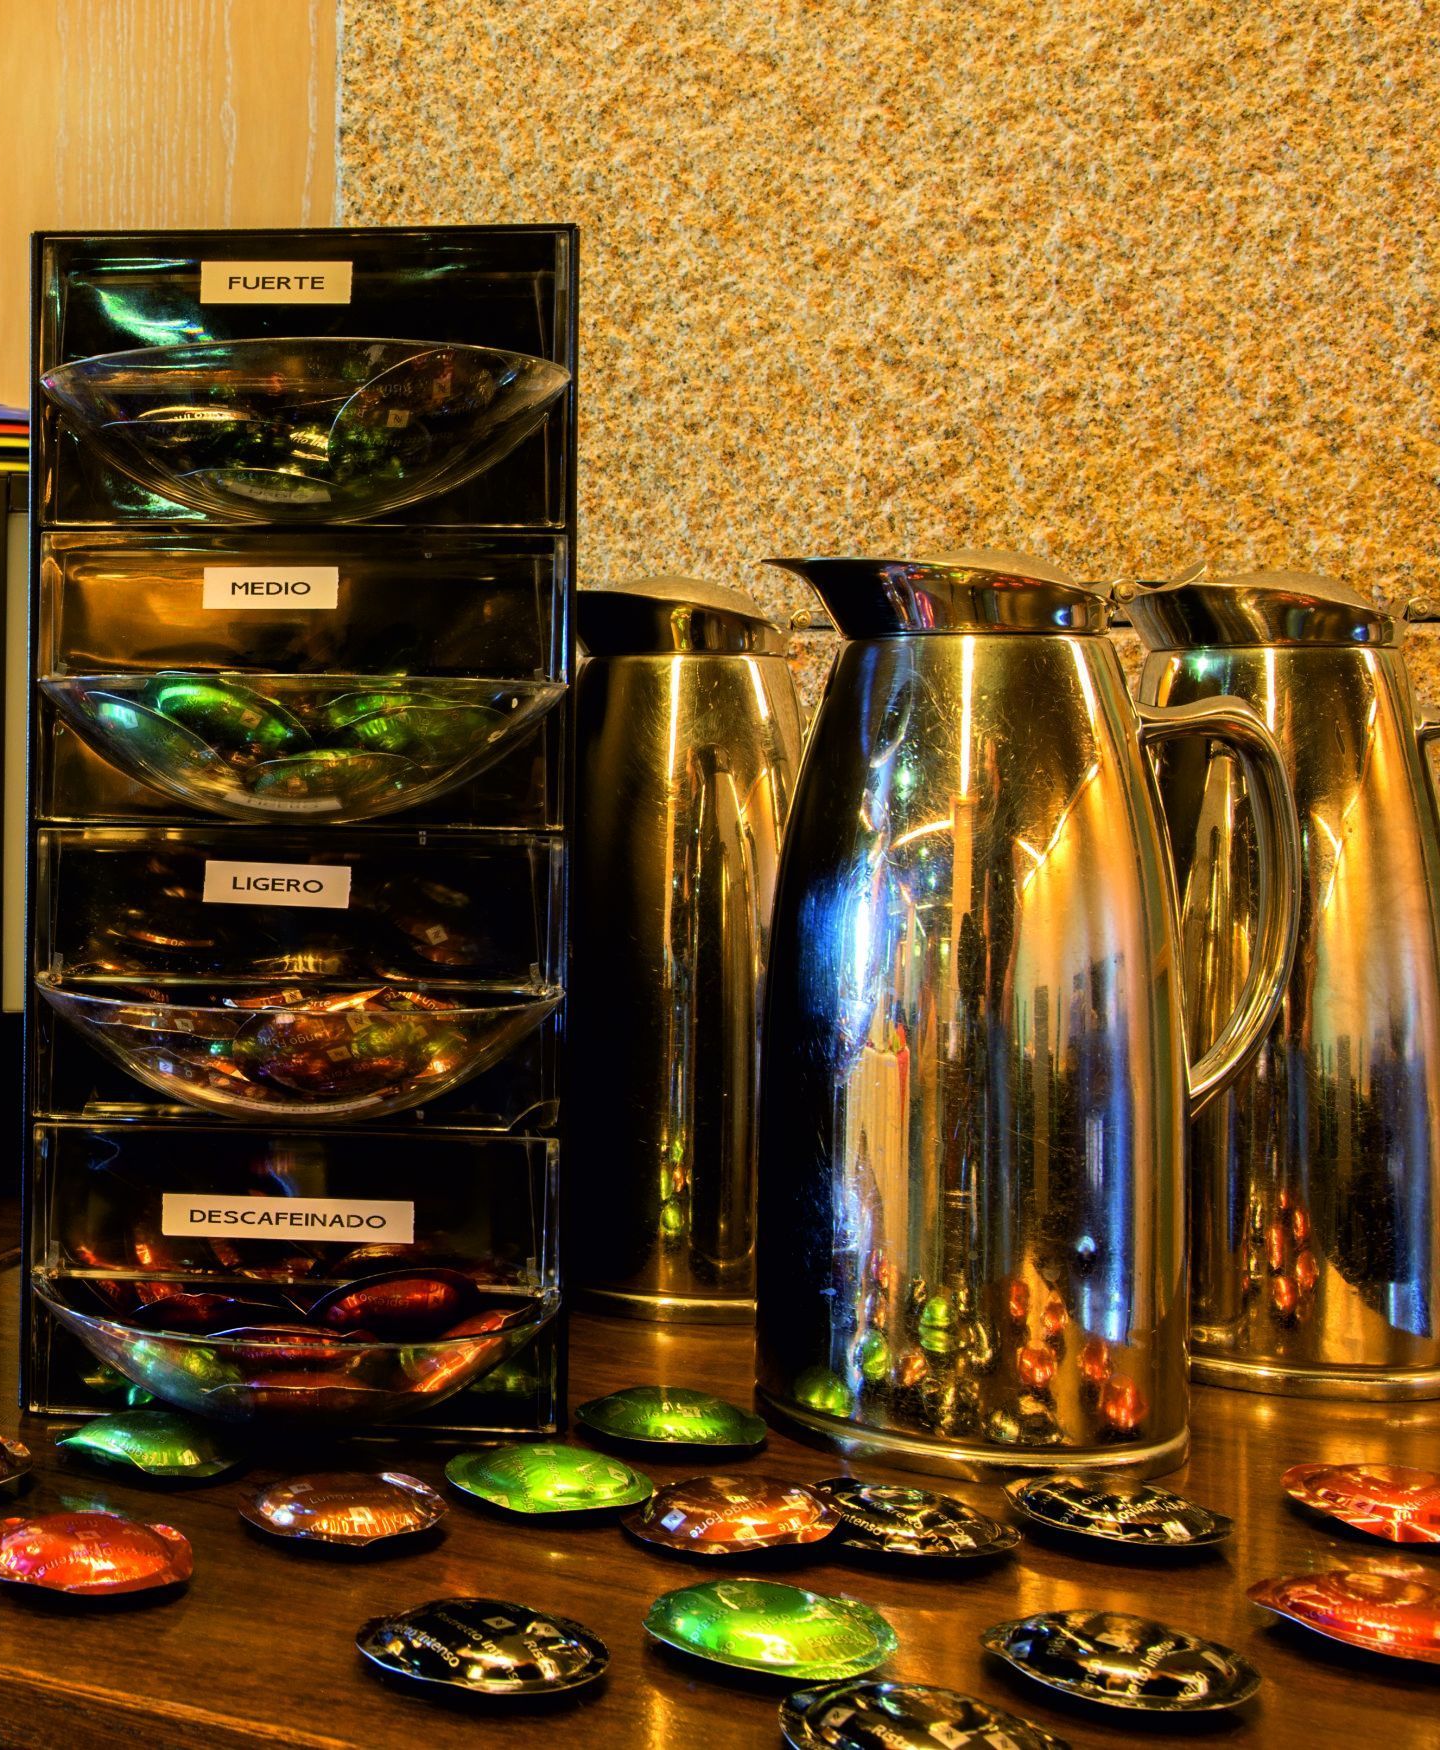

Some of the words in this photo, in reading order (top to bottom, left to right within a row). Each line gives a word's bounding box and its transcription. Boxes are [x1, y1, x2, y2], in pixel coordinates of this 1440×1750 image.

[228, 276, 325, 290] FUERTE
[231, 582, 311, 596] MEDIO
[232, 876, 324, 894] LIGERO
[306, 999, 333, 1010] orte
[189, 1208, 387, 1229] DESCAFEINADO
[724, 1500, 769, 1517] Lungo
[689, 1509, 725, 1539] Forte
[842, 1511, 882, 1536] ntenso
[417, 1630, 460, 1668] Intenso
